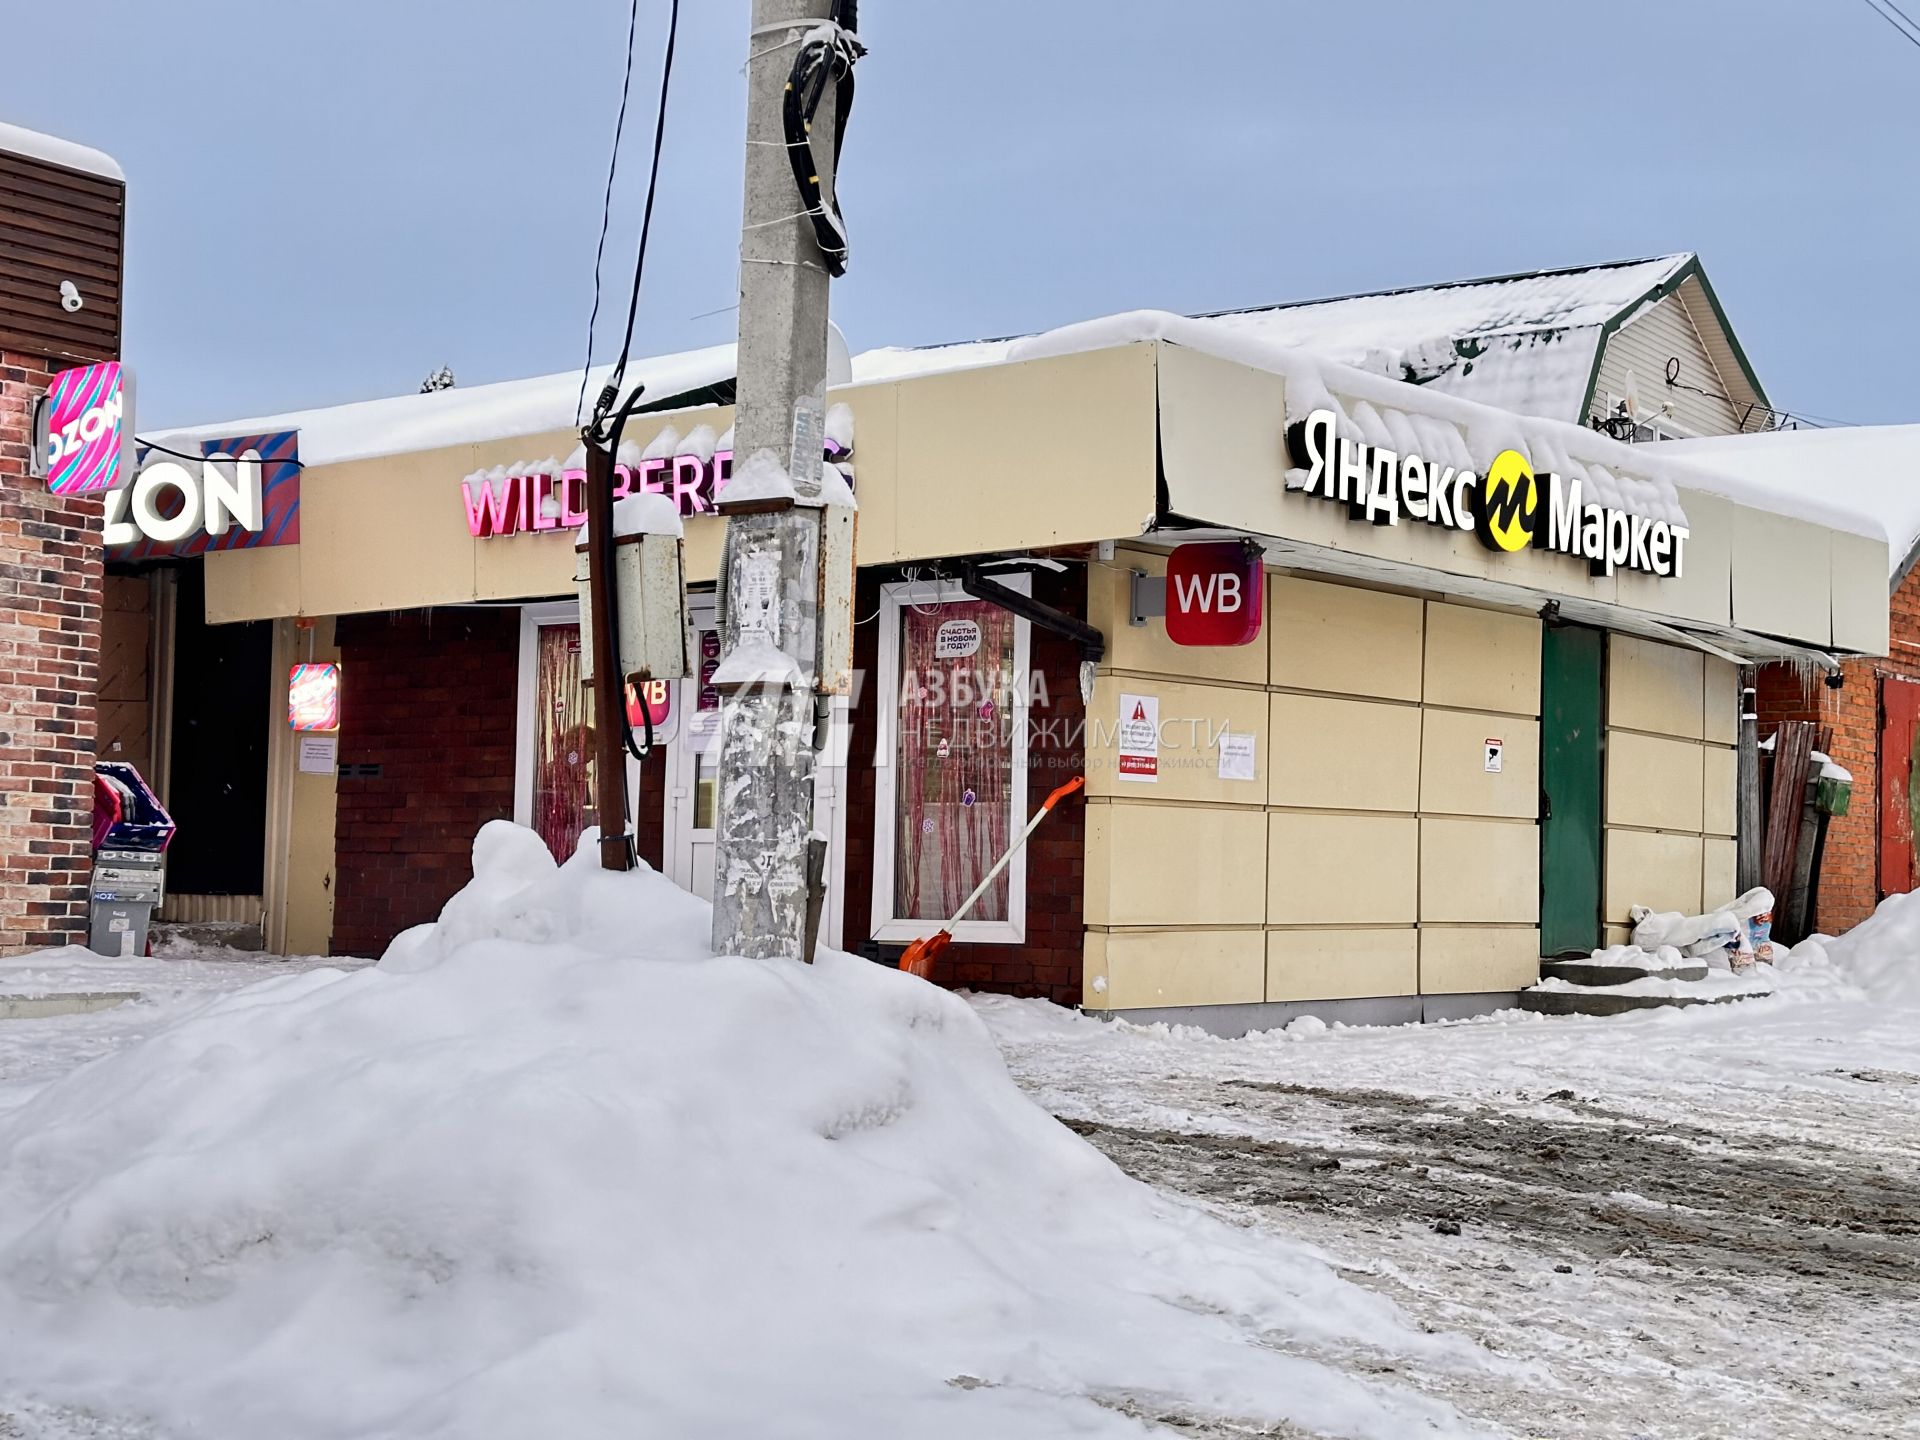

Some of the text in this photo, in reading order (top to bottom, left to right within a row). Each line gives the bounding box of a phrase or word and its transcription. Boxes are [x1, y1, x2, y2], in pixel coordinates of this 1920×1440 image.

[48, 391, 123, 465] OZON
[1303, 408, 1477, 531] Яндекс
[1548, 471, 1690, 578] Маркет
[1174, 573, 1241, 613] WB
[941, 627, 977, 635] СЧАСТЬЯ
[947, 642, 970, 650] ГОДУ!
[626, 680, 667, 706] WB
